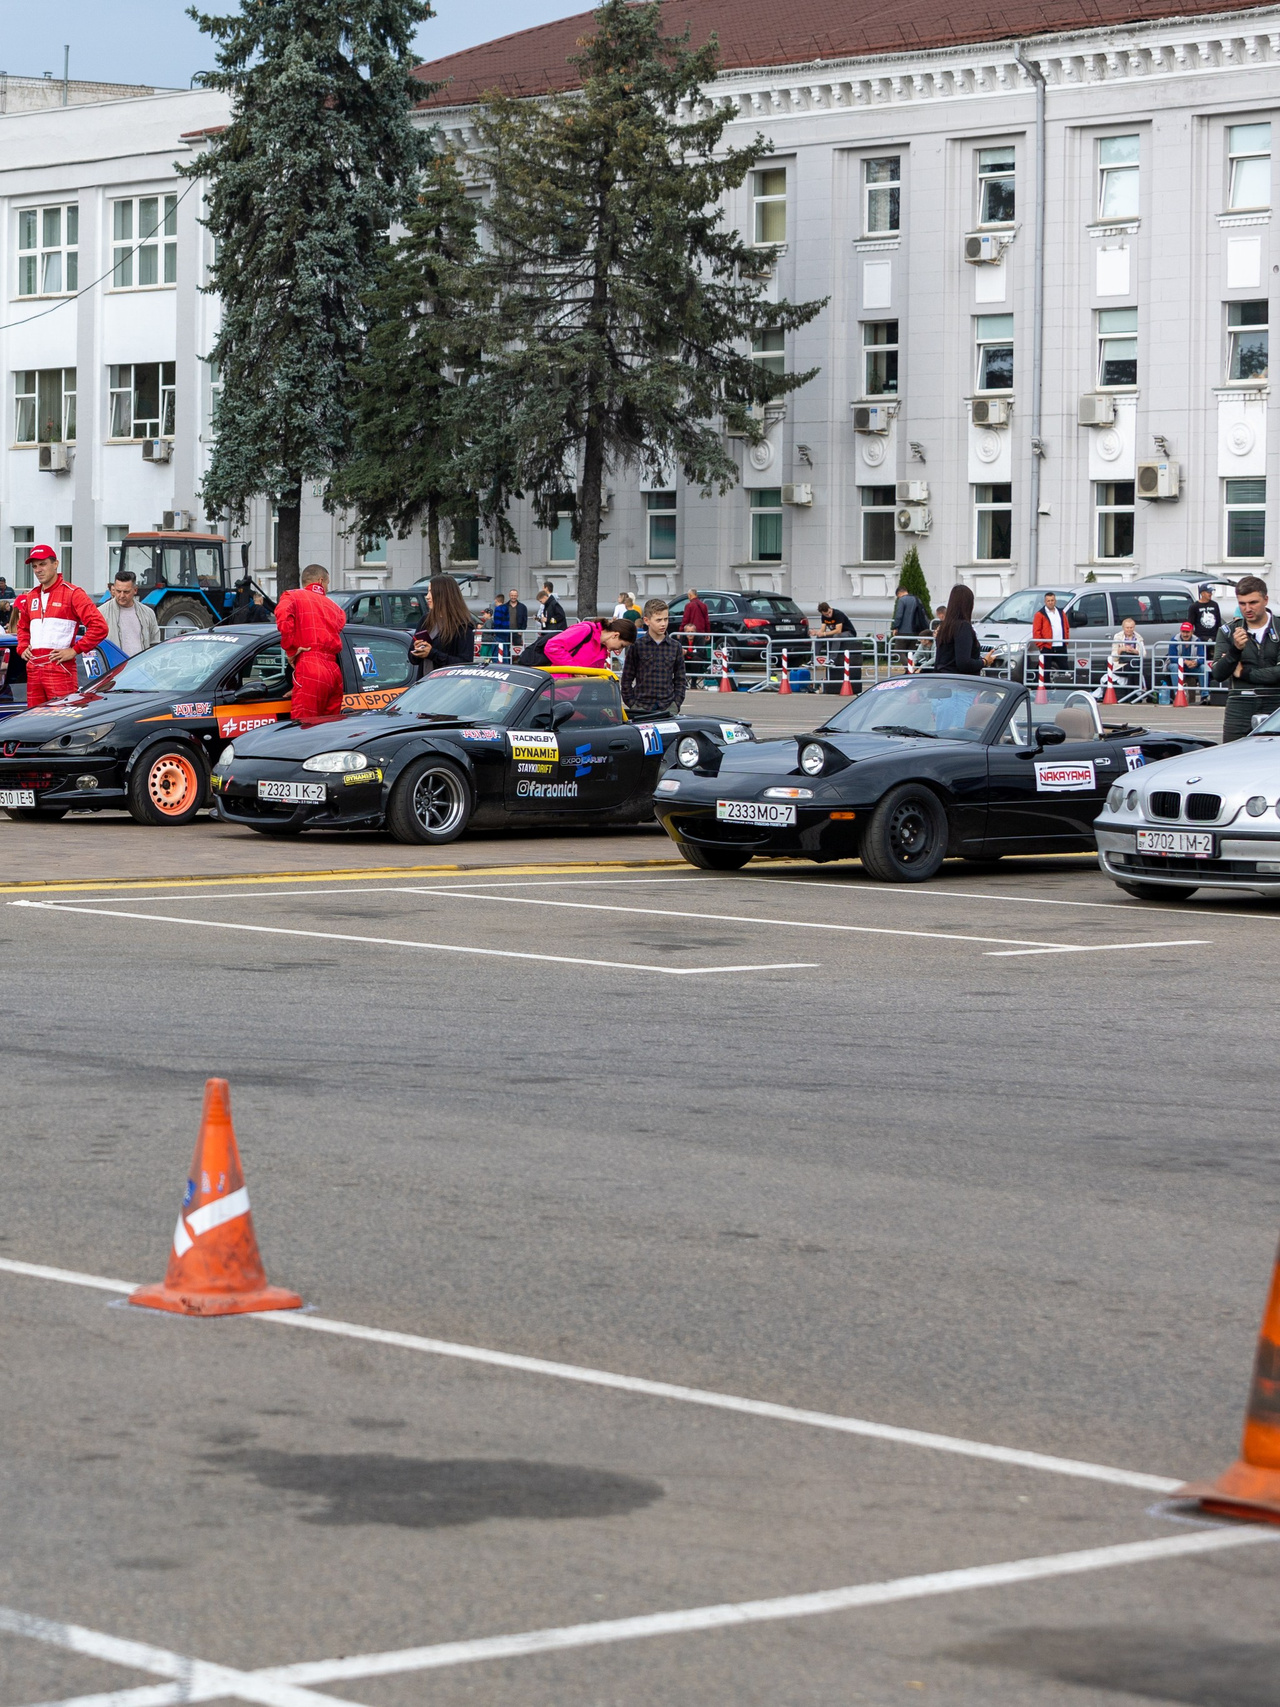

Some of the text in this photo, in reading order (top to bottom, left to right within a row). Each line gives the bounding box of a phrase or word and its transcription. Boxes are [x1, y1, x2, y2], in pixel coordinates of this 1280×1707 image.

[85, 659, 101, 676] 13
[359, 655, 376, 675] 12
[365, 691, 402, 706] SPOR
[644, 730, 659, 752] 11
[1039, 770, 1091, 782] NAKAYAMA
[267, 783, 291, 798] 2323
[529, 780, 578, 797] faraonich
[16, 792, 34, 804] IE-5
[1147, 833, 1210, 851] 3702 IM-2
